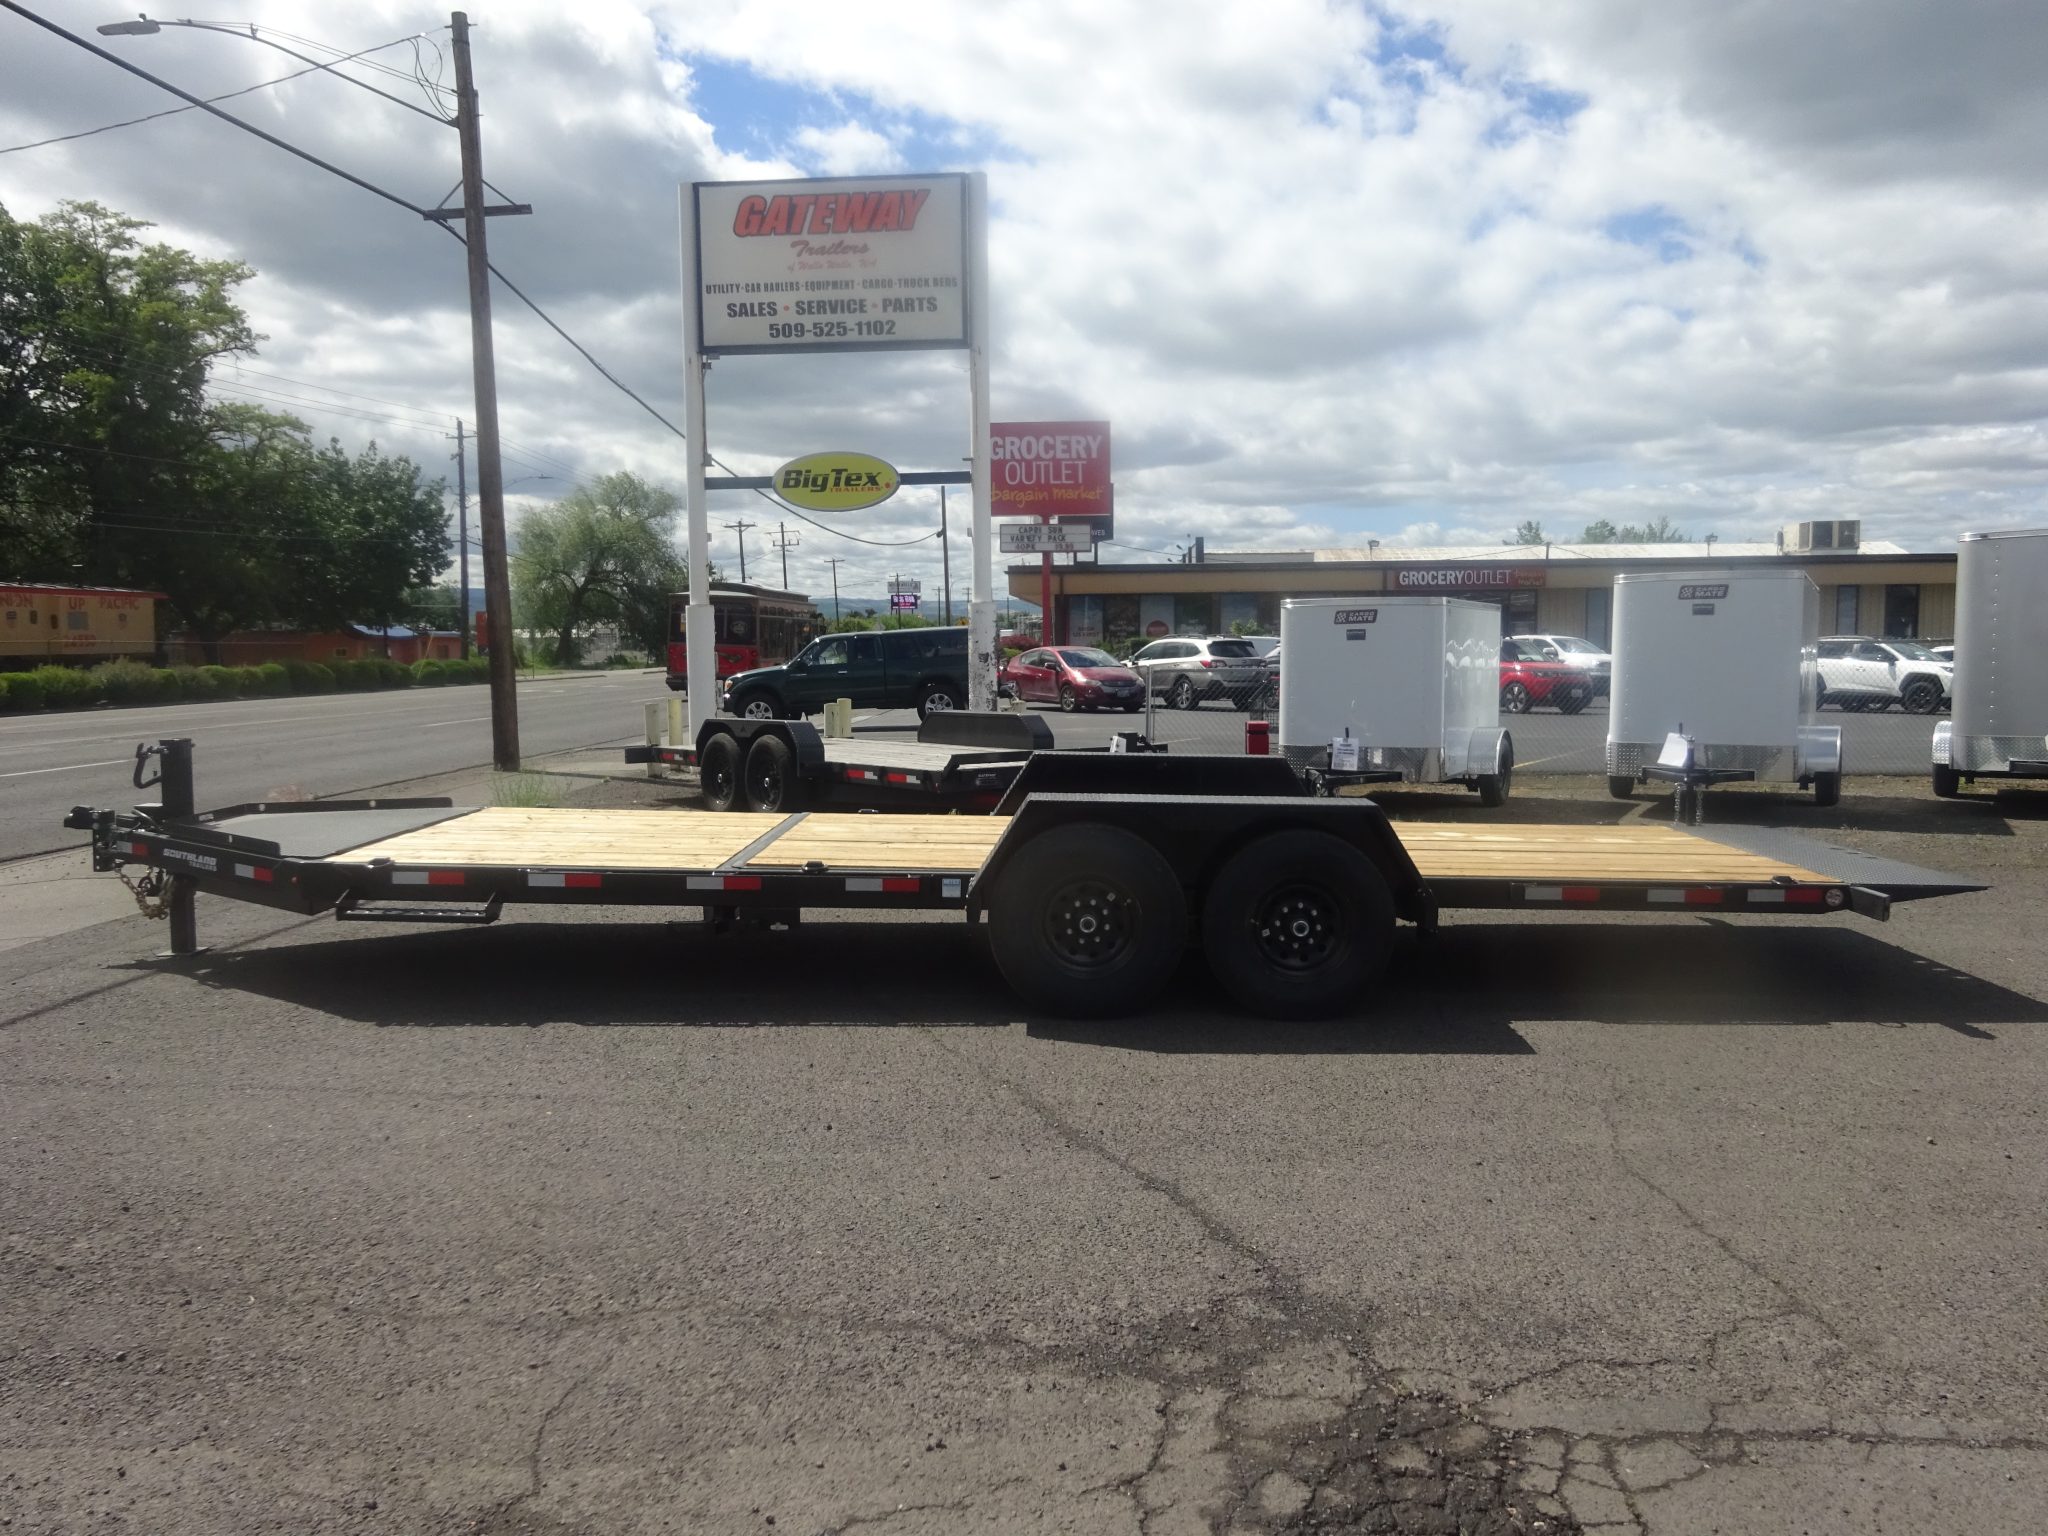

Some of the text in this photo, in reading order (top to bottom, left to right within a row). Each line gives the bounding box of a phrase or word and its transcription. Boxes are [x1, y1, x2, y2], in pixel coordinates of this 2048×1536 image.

[733, 189, 930, 238] GATEWAY
[789, 239, 870, 258] Trailers
[726, 296, 939, 319] SALES SERVICE PARTS
[768, 319, 897, 339] 509-525-1102
[990, 434, 1103, 461] GROCERY
[1004, 460, 1088, 486] OUTLET
[829, 485, 882, 494] TRAILERS
[991, 481, 1105, 509] bargain market
[1047, 534, 1067, 544] PACK
[68, 598, 86, 611] UP
[1694, 591, 1725, 599] MATE
[163, 848, 217, 865] SOUTHLAND
